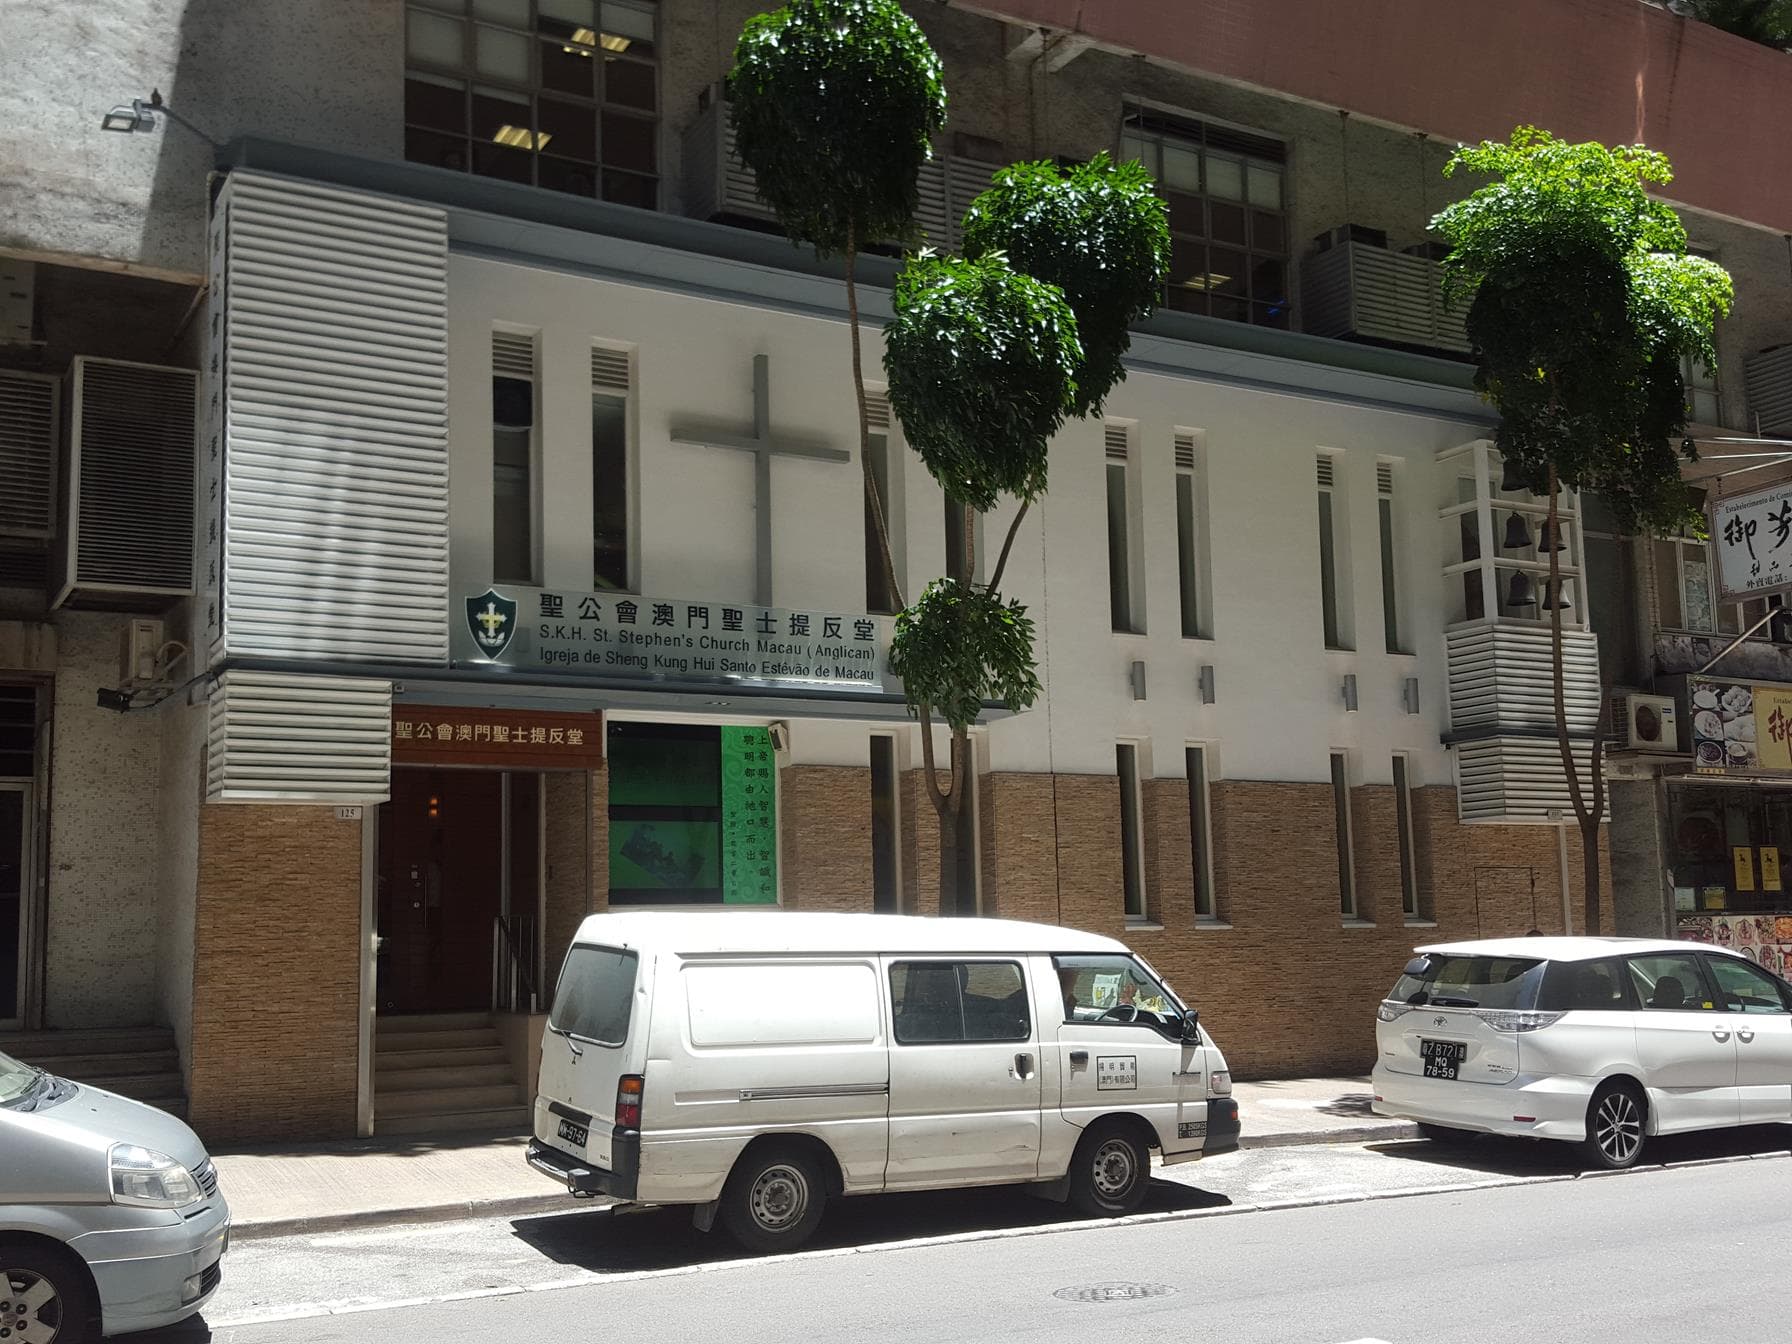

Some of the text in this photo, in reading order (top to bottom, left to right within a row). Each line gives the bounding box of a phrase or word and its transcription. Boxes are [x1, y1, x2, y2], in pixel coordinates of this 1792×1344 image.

[540, 592, 875, 642] 聖公會澳門聖士提反堂
[540, 624, 586, 641] S.K.H.
[593, 628, 612, 643] St.
[619, 630, 694, 649] Stephen's
[700, 636, 750, 651] Church
[757, 639, 801, 656] Macau
[540, 647, 874, 680] Igreja de Sheng Kung Hui Santo Estêvão de Macau
[395, 720, 584, 746] 聖公會澳門聖士提反堂
[340, 808, 354, 818] 125
[1426, 1065, 1455, 1079] 78-59
[1435, 1056, 1448, 1067] MQ
